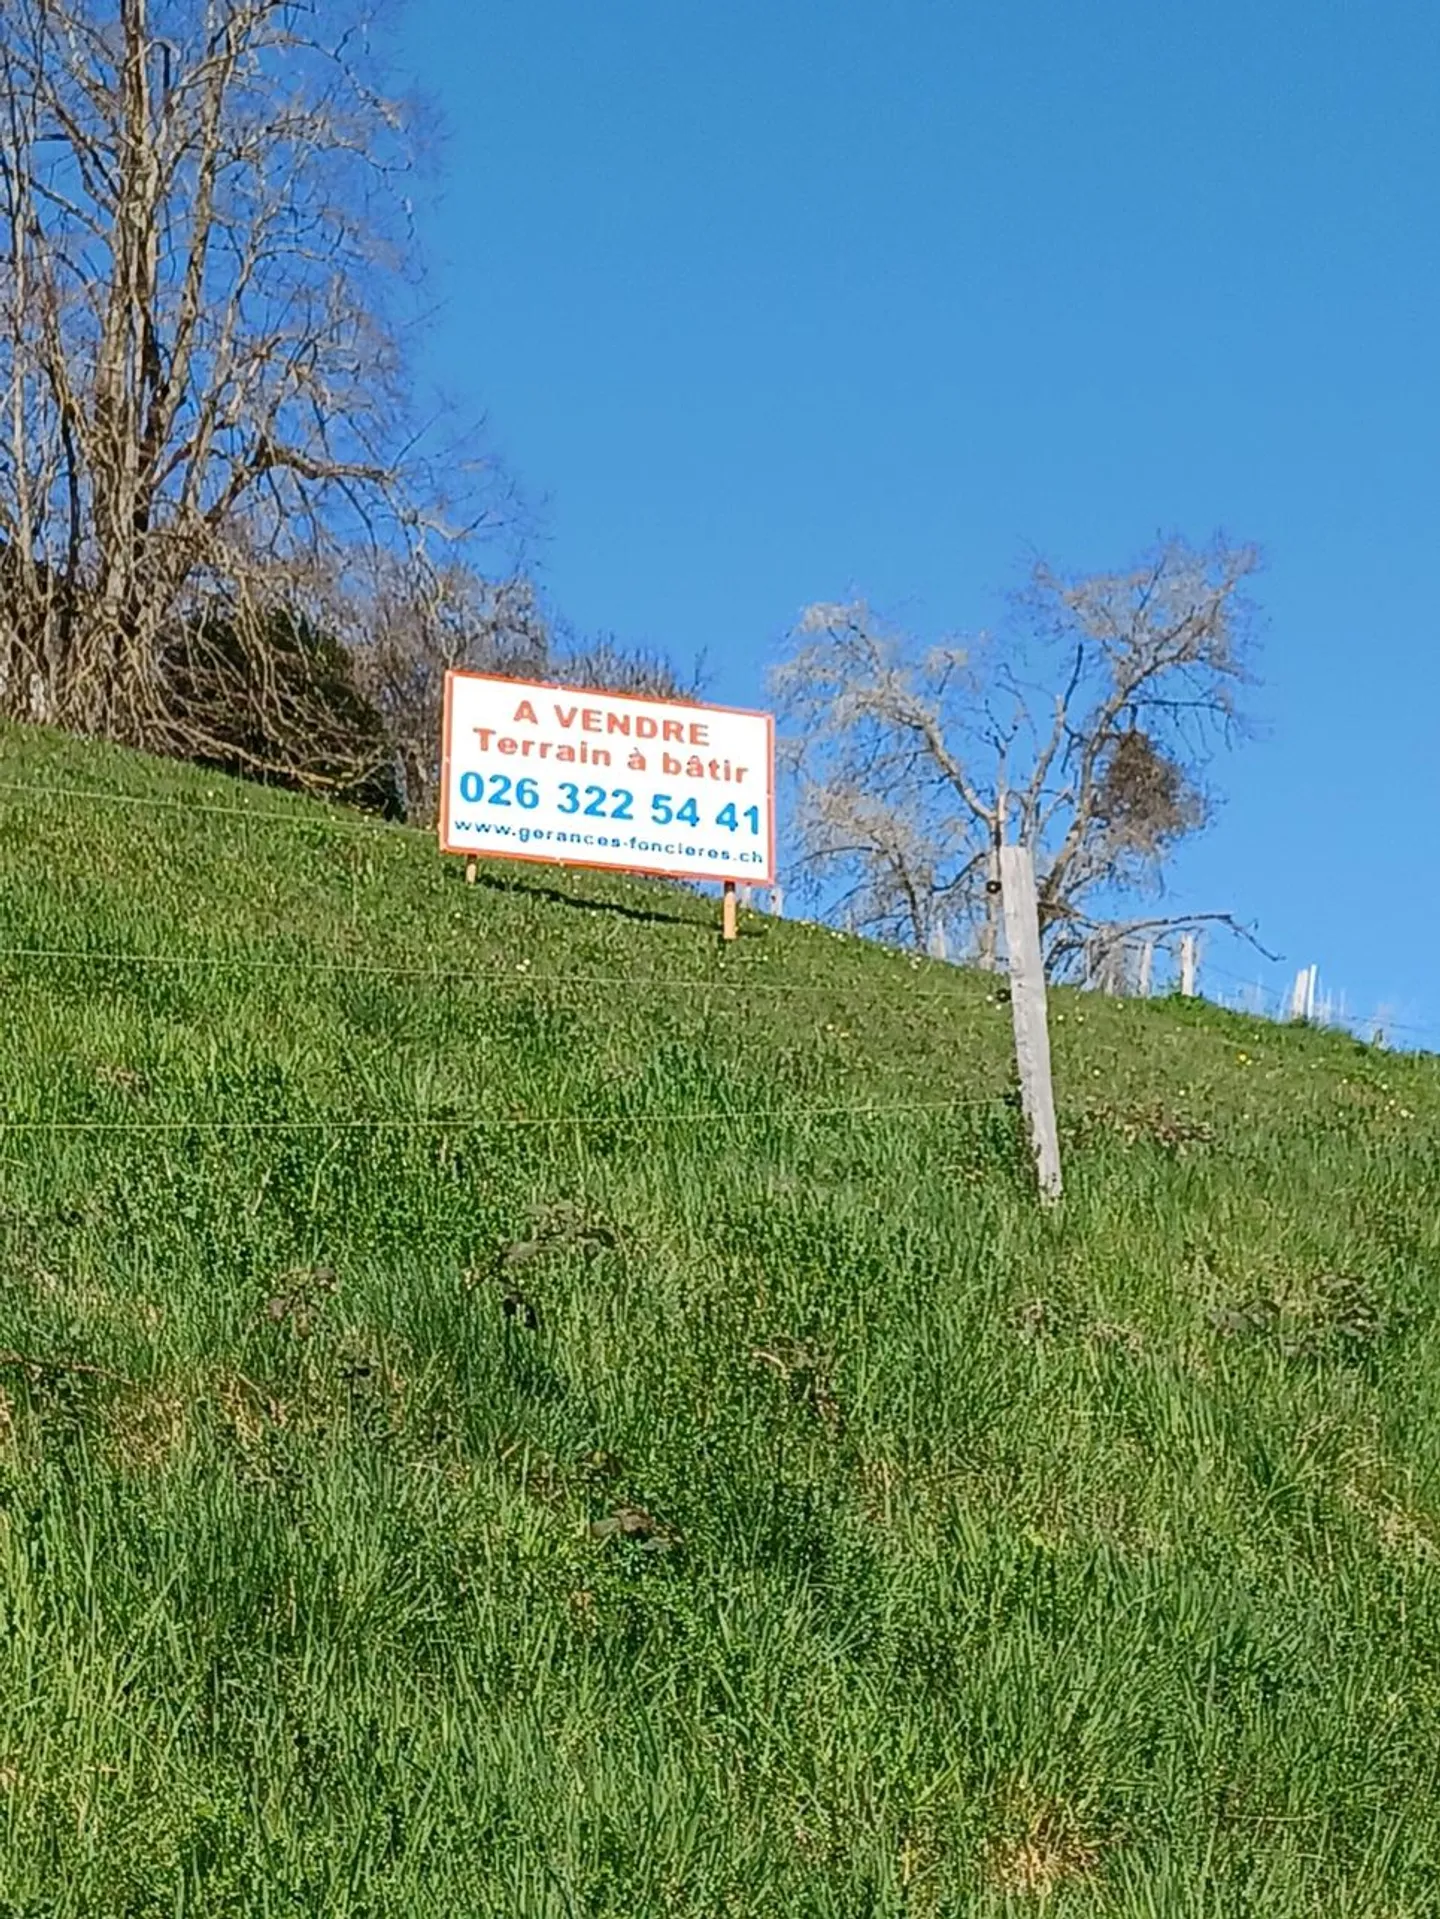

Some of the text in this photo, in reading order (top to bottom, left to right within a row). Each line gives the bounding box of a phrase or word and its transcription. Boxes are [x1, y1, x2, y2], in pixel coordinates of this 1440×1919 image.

[514, 700, 709, 747] A VENDRE
[472, 727, 748, 783] Terrain à bâtir
[459, 771, 759, 835] 026 322 54 41
